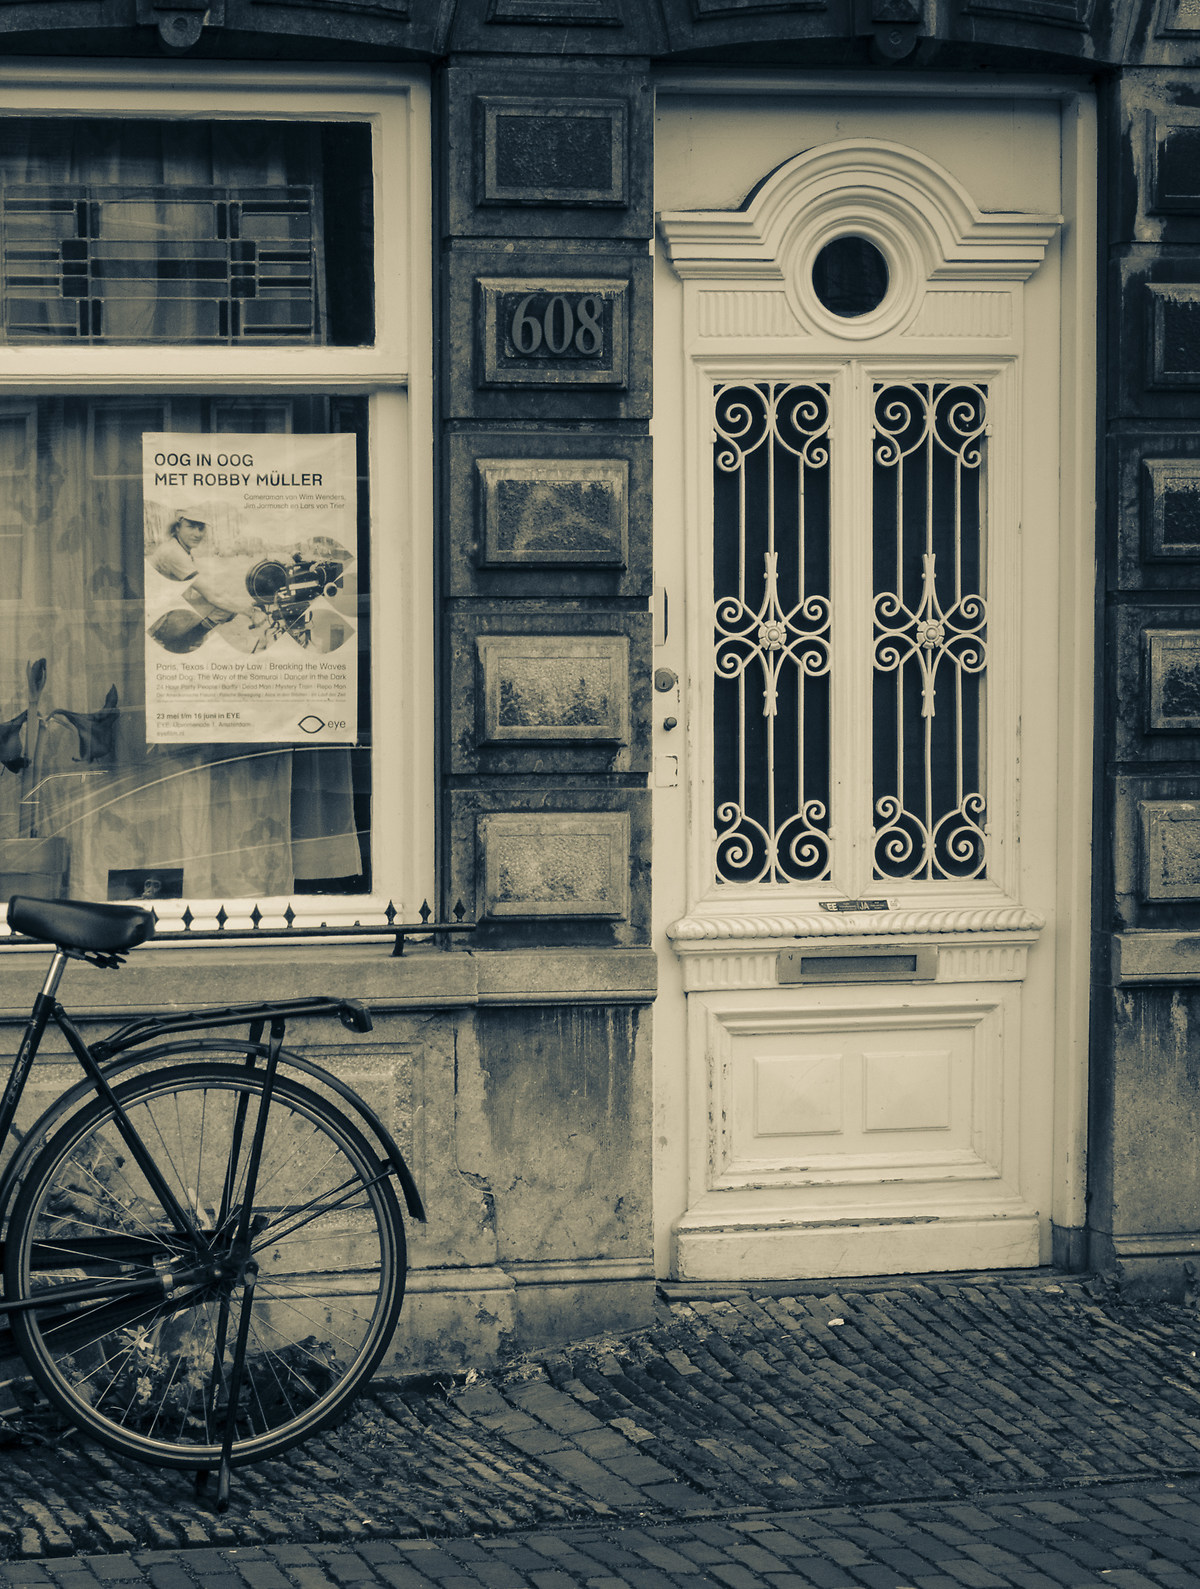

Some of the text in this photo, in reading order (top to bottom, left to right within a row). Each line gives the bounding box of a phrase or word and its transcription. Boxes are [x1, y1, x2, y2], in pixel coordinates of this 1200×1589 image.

[511, 293, 604, 355] 608
[154, 453, 254, 467] OOG IN OOG
[154, 470, 323, 486] MET ROBBY MÜLLER
[235, 663, 245, 672] by
[269, 662, 304, 672] Breaking
[305, 662, 318, 670] the
[320, 662, 346, 670] Waves
[212, 674, 226, 682] Way
[327, 720, 346, 730] eye
[859, 902, 870, 910] JA
